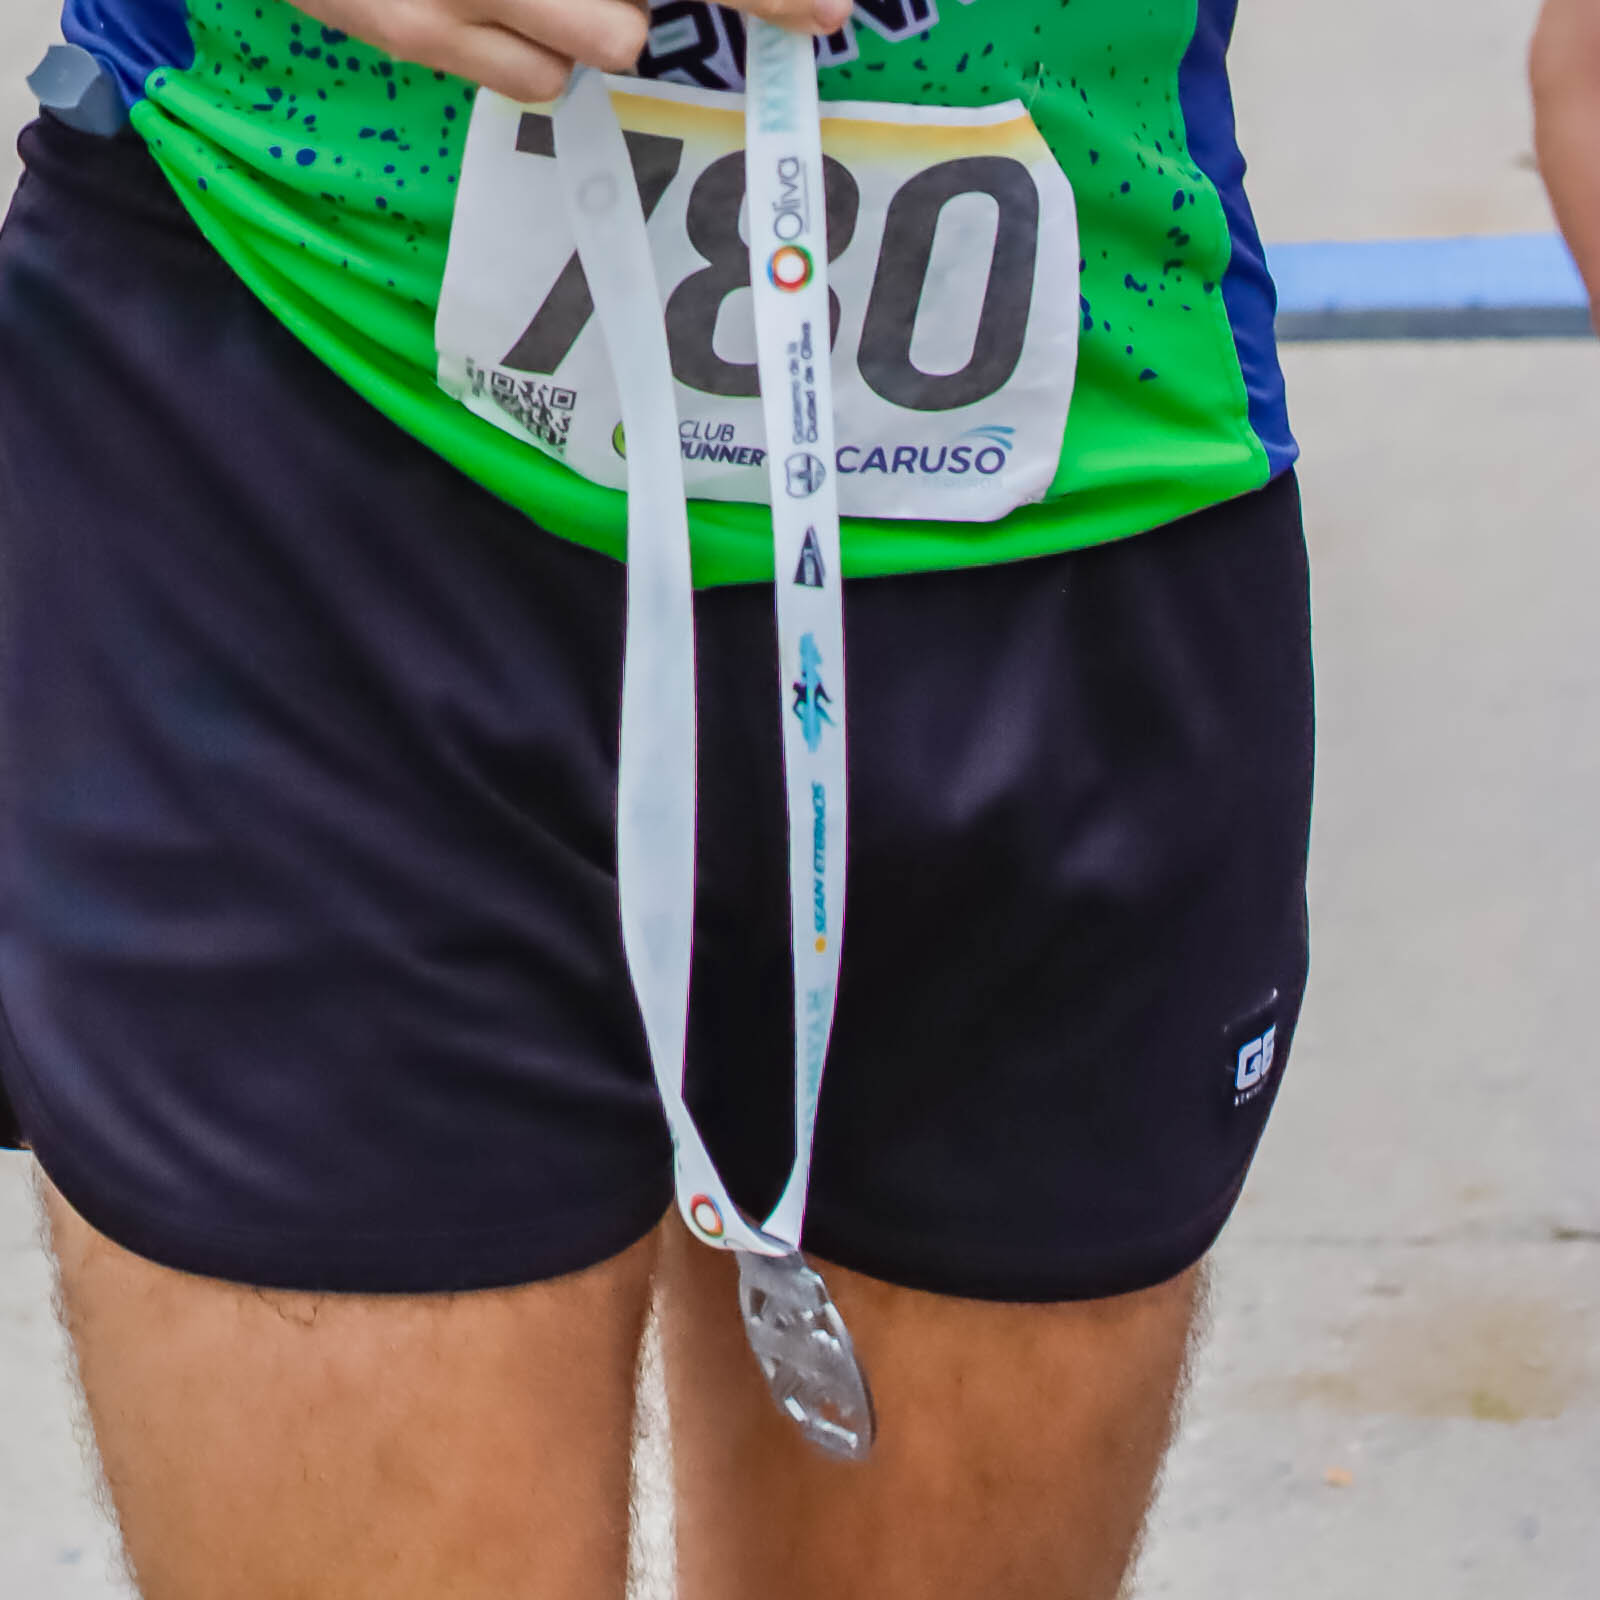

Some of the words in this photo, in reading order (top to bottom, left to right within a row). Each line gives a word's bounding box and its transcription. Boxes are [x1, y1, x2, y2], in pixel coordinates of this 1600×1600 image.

[773, 155, 802, 241] Oliva
[679, 420, 735, 442] CLUB
[836, 446, 1006, 475] CARUSO
